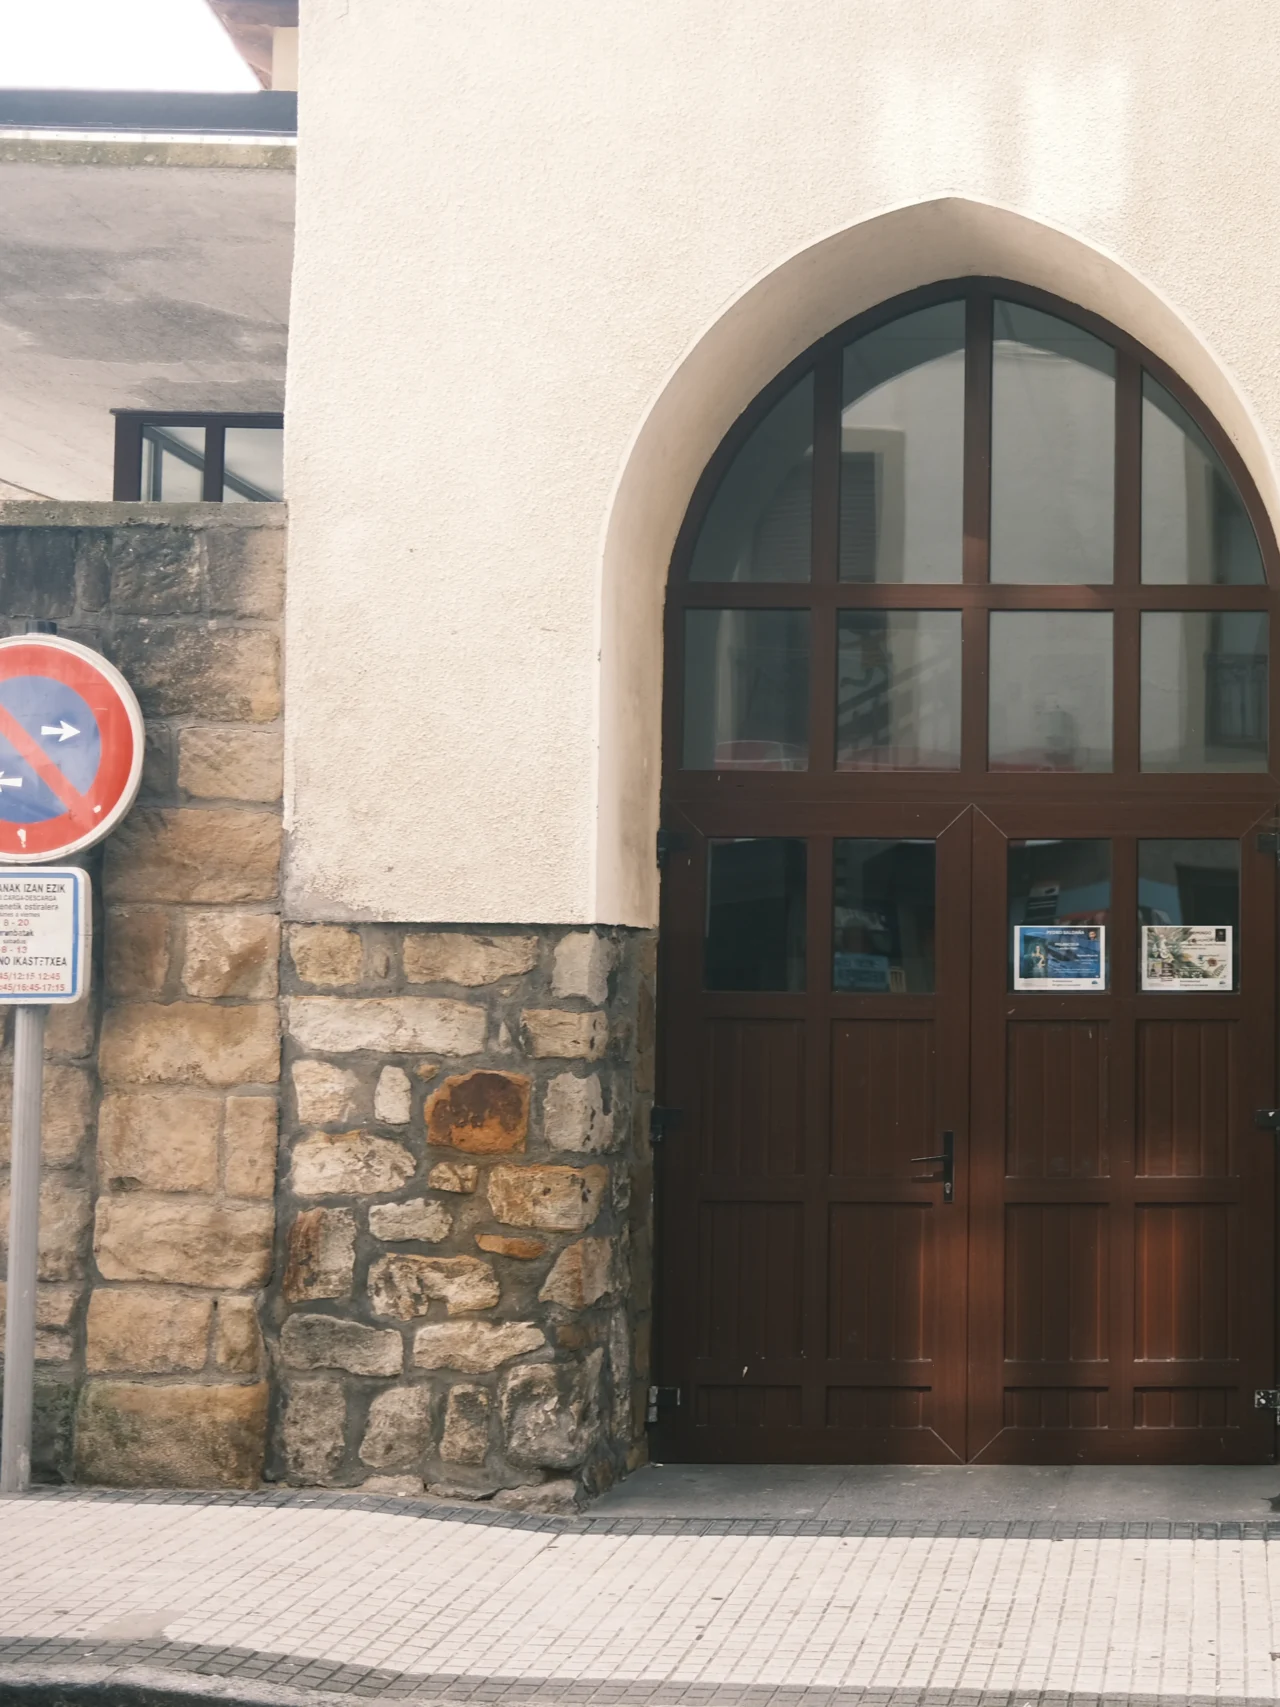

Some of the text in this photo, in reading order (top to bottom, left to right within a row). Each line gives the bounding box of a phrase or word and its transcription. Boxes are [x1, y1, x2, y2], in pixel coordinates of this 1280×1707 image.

[24, 884, 43, 893] IZAN
[46, 884, 66, 893] EZIK
[17, 946, 27, 954] 13
[13, 957, 67, 966] IKASTETXEA
